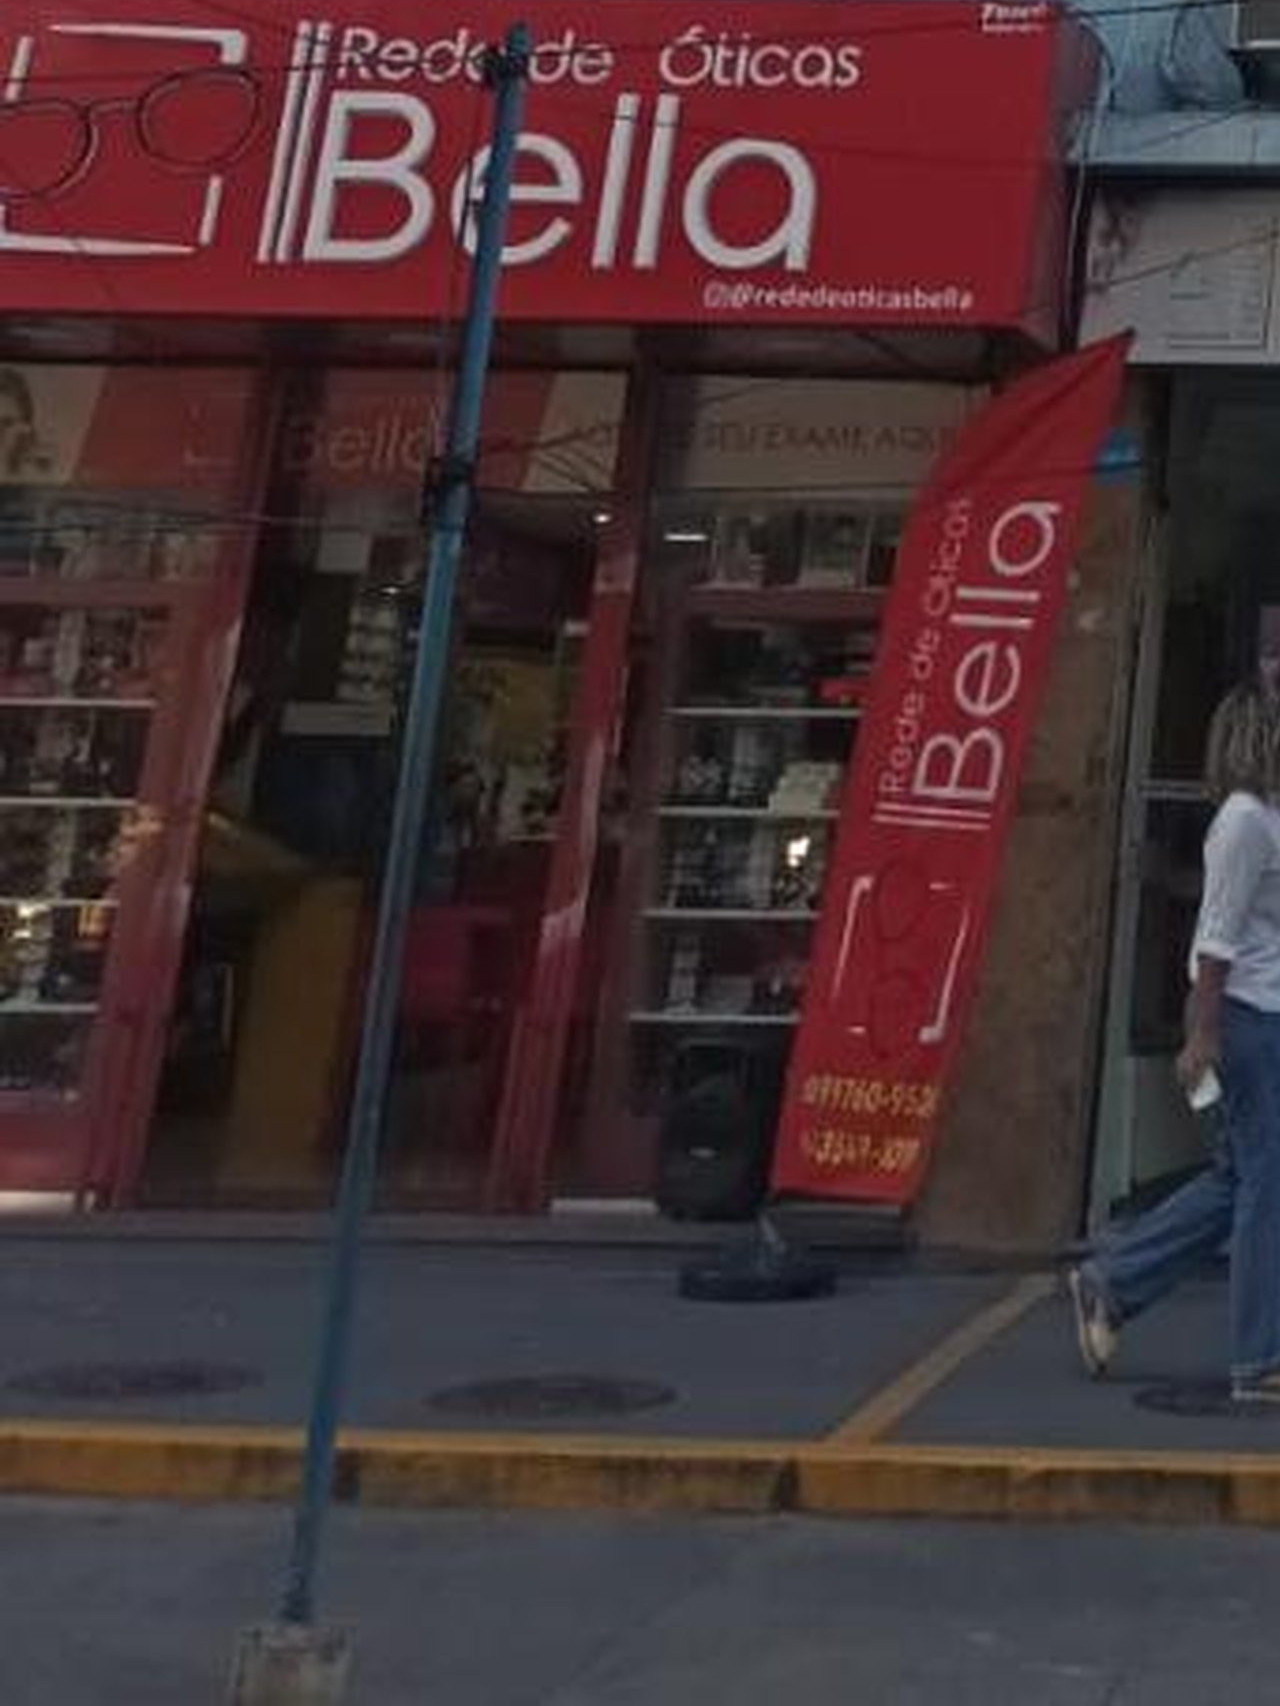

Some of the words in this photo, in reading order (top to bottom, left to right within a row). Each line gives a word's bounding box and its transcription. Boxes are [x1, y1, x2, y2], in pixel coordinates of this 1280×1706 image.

[660, 25, 864, 89] Óticas
[303, 91, 818, 271] Bella
[913, 499, 1063, 803] Bella
